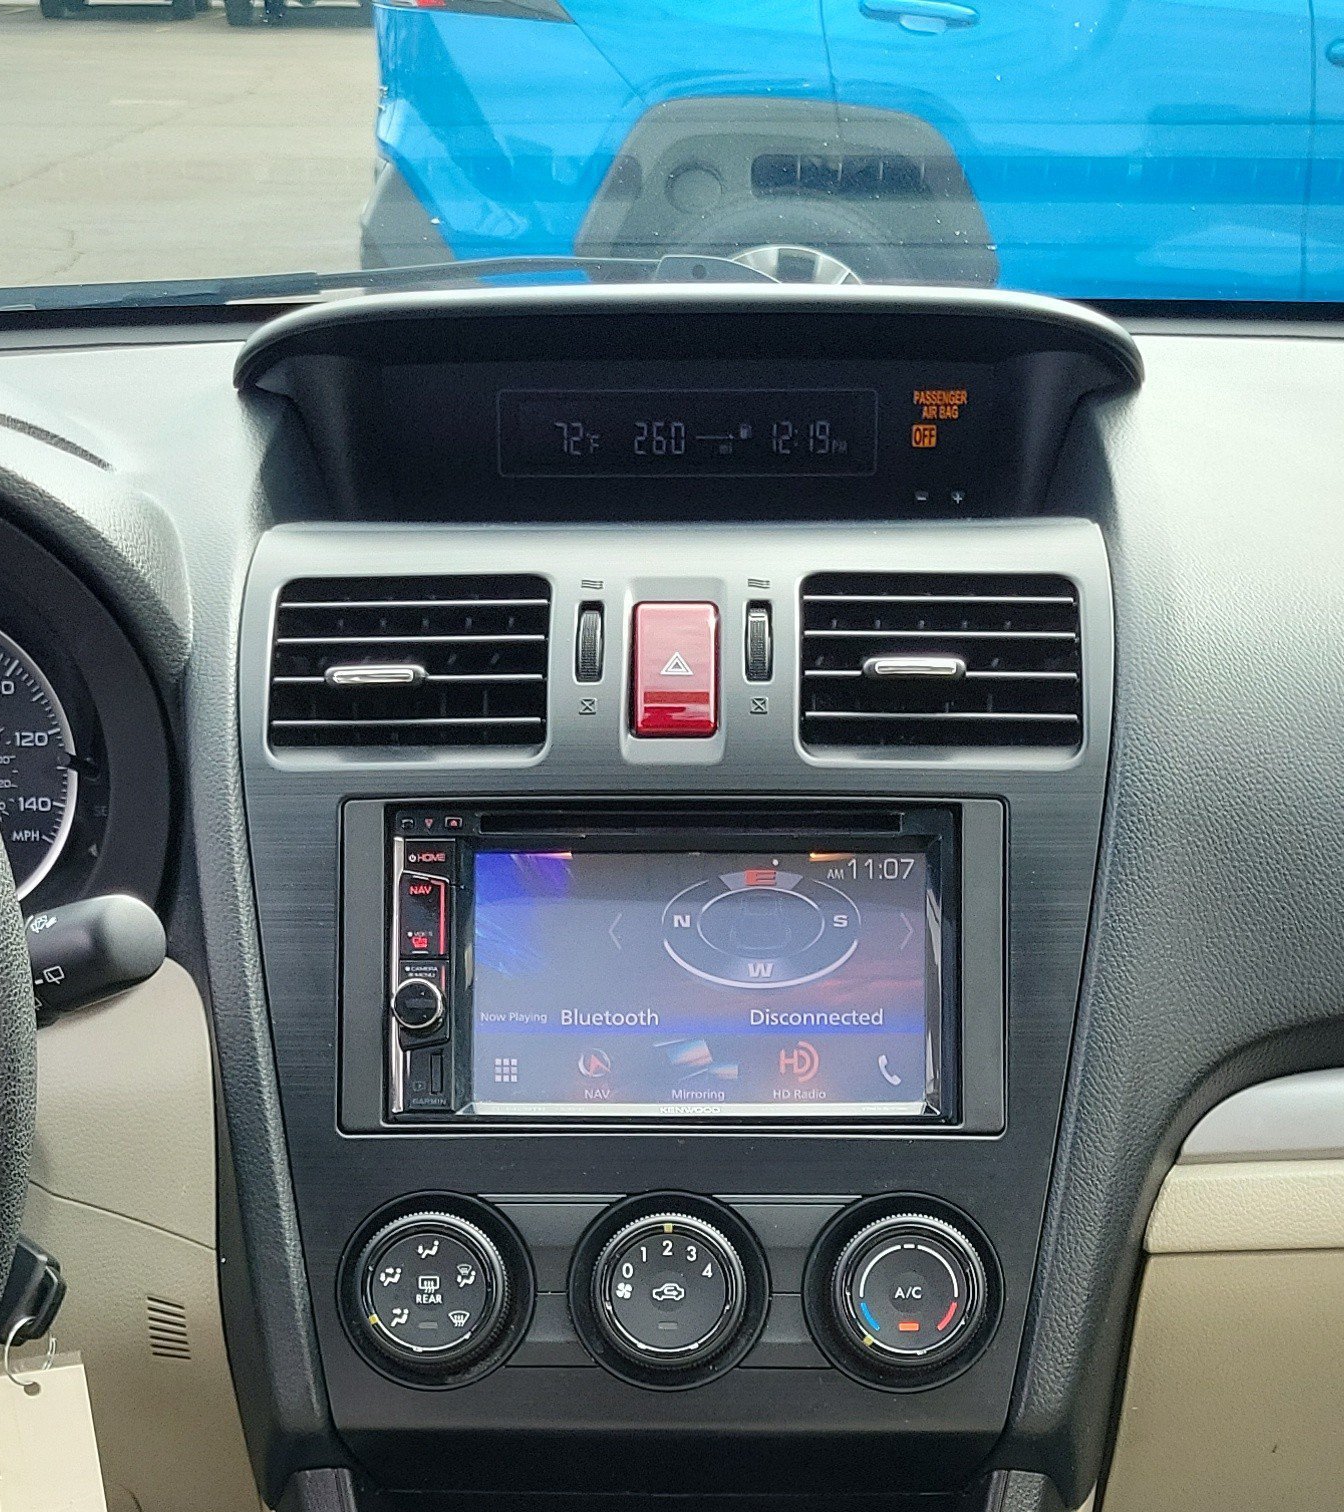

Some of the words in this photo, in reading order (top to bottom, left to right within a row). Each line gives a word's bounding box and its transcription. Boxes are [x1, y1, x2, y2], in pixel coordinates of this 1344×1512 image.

[913, 390, 968, 405] PASSENGER
[922, 405, 937, 419] AIR
[939, 405, 959, 419] BAG
[635, 422, 685, 455] 260
[913, 427, 935, 446] OFF
[15, 731, 48, 746] 120
[18, 796, 52, 812] 140
[12, 830, 41, 842] MPH
[417, 853, 446, 862] HOME
[827, 869, 844, 880] AM
[848, 858, 915, 880] 11:07
[743, 869, 777, 887] E
[409, 885, 432, 895] NAV
[673, 914, 691, 928] N
[833, 914, 848, 928] S
[747, 962, 774, 978] W
[480, 1012, 506, 1023] Now
[509, 1012, 548, 1024] Playing
[561, 1008, 659, 1026] Bluetooth
[750, 1008, 884, 1026] Disconnected
[584, 1089, 610, 1100] NAV
[671, 1088, 725, 1101] Mirroring
[773, 1089, 790, 1099] HD
[794, 1088, 827, 1100] Radio
[659, 1106, 721, 1114] KENWOOD
[640, 1246, 647, 1262] 1
[662, 1240, 673, 1256] 2
[686, 1246, 697, 1262] 3
[622, 1262, 634, 1278] 0
[702, 1262, 713, 1278] 4
[416, 1294, 442, 1304] REAR
[894, 1286, 922, 1299] A/C
